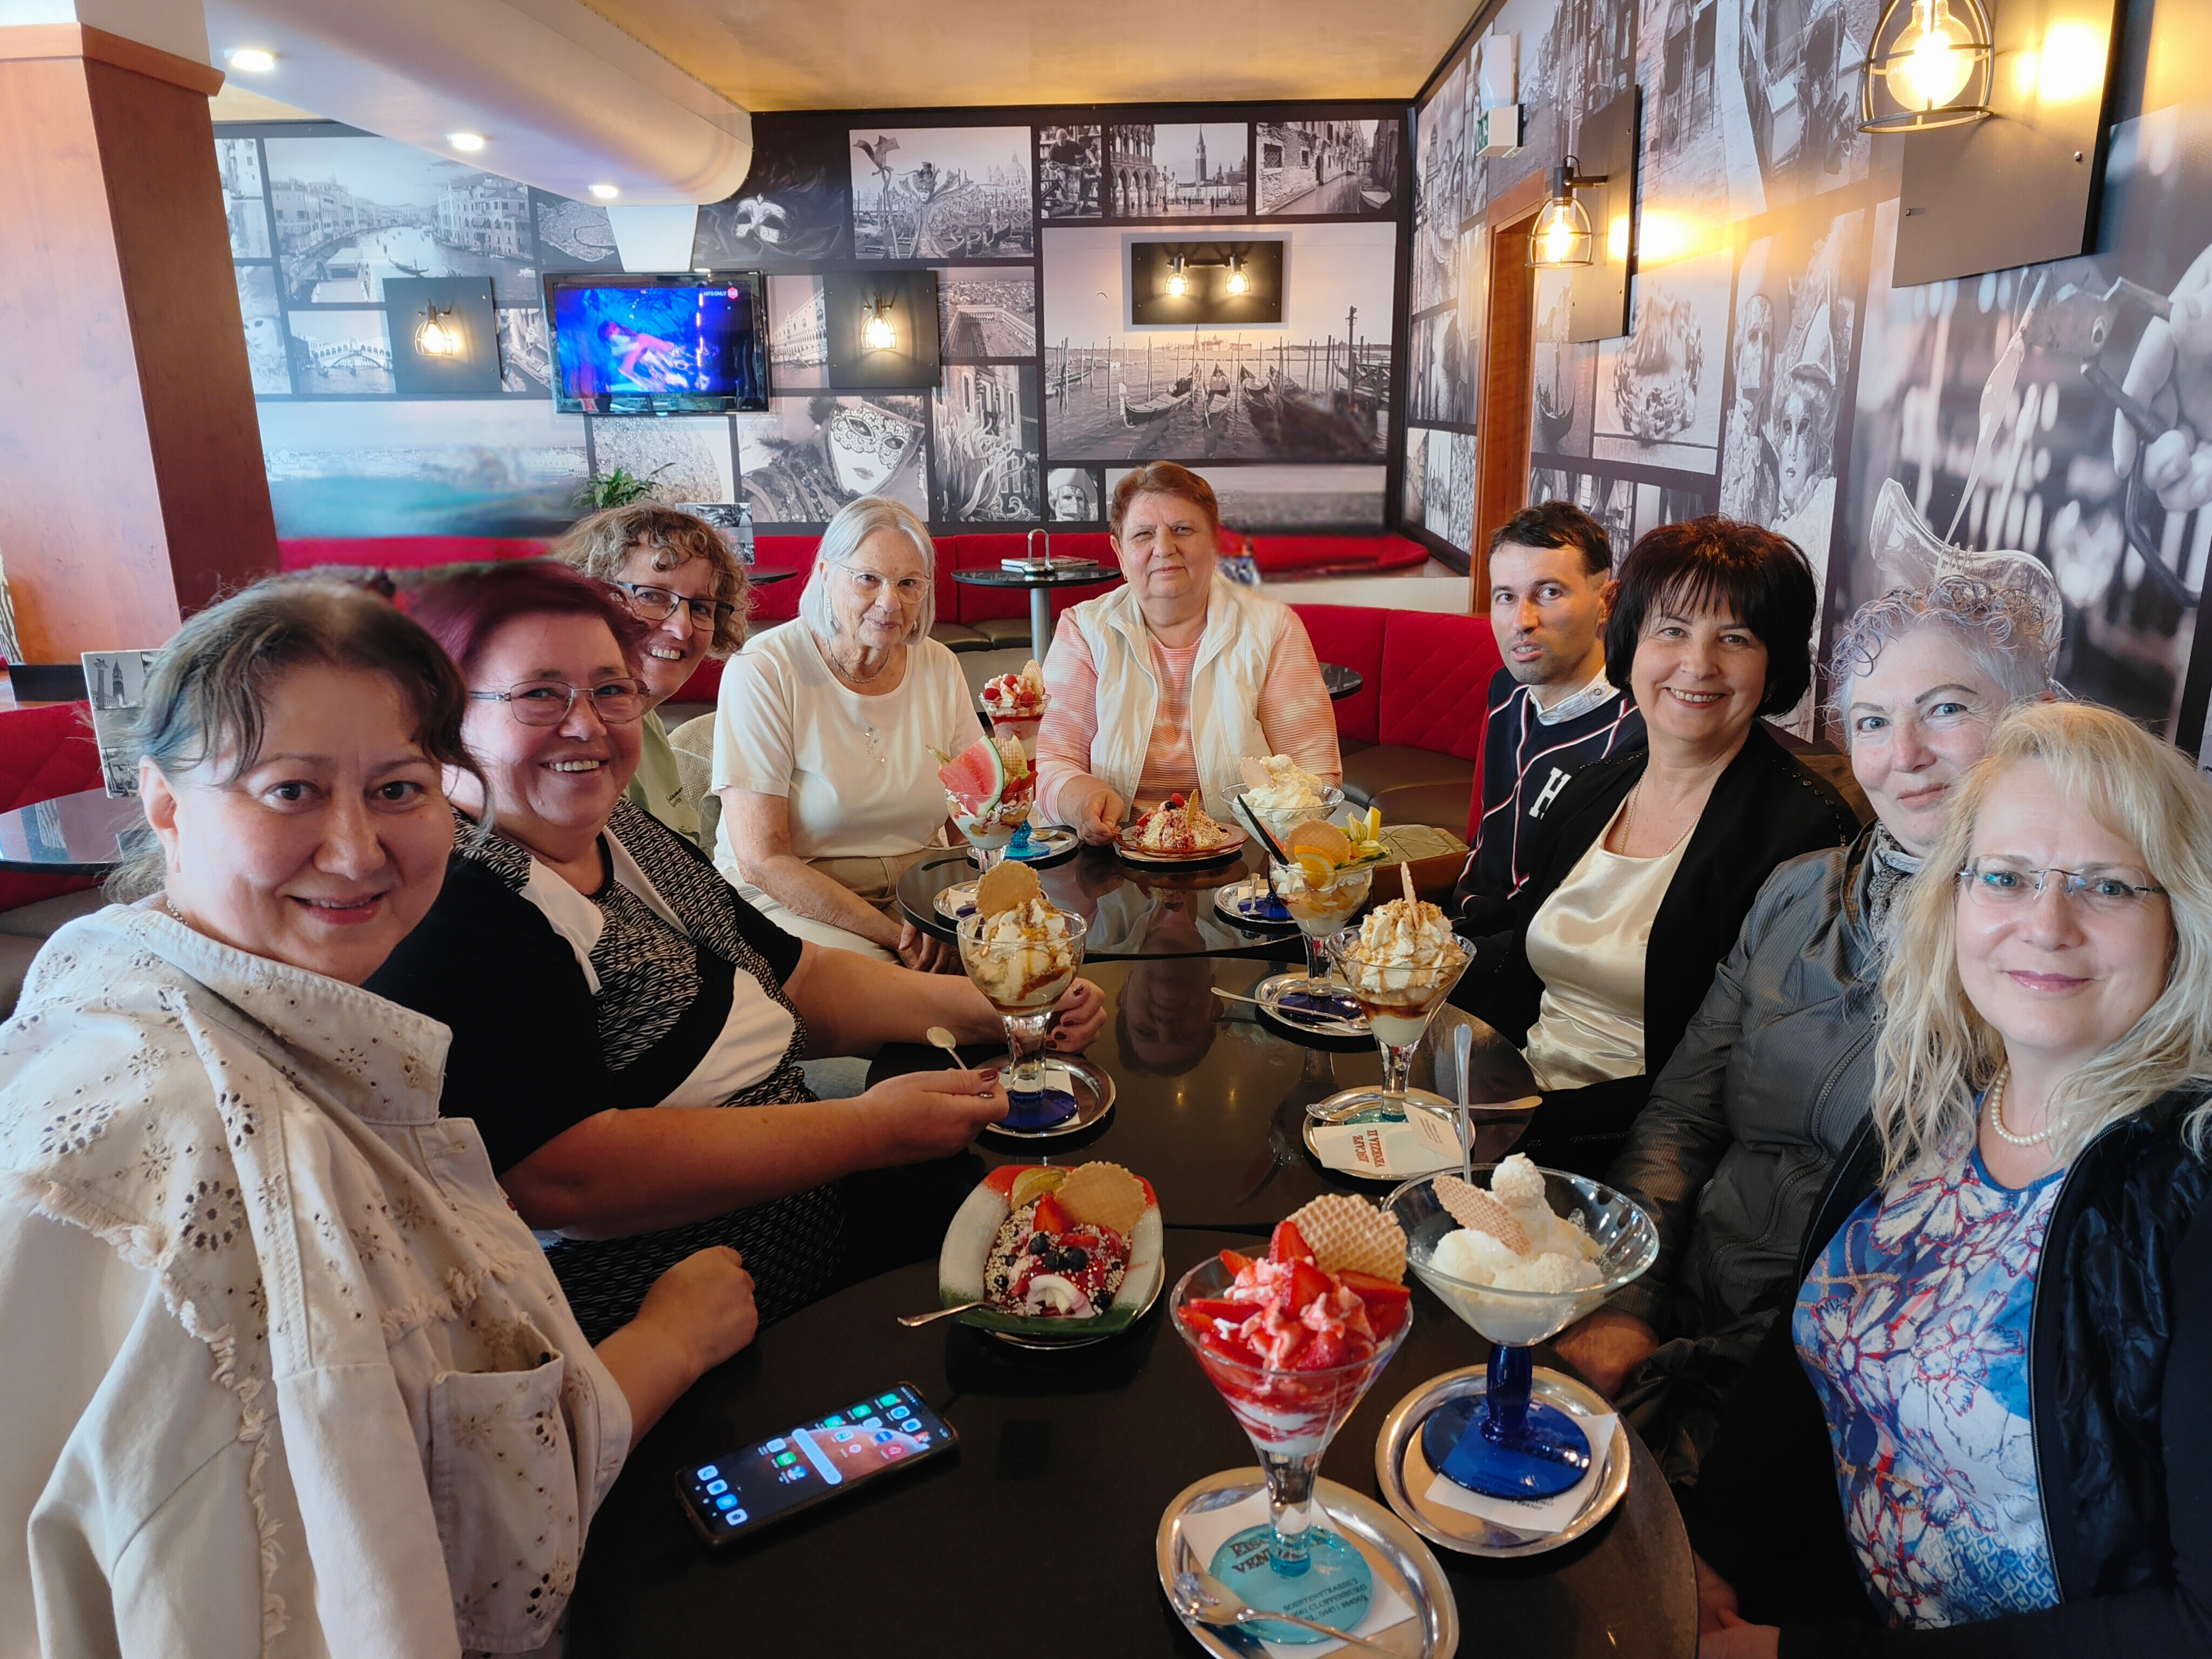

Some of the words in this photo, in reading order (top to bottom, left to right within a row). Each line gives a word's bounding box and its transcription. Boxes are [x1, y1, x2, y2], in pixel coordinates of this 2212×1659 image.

[1528, 767, 1572, 820] H
[1366, 1129, 1379, 1137] II
[1367, 1137, 1386, 1168] VENEZIA
